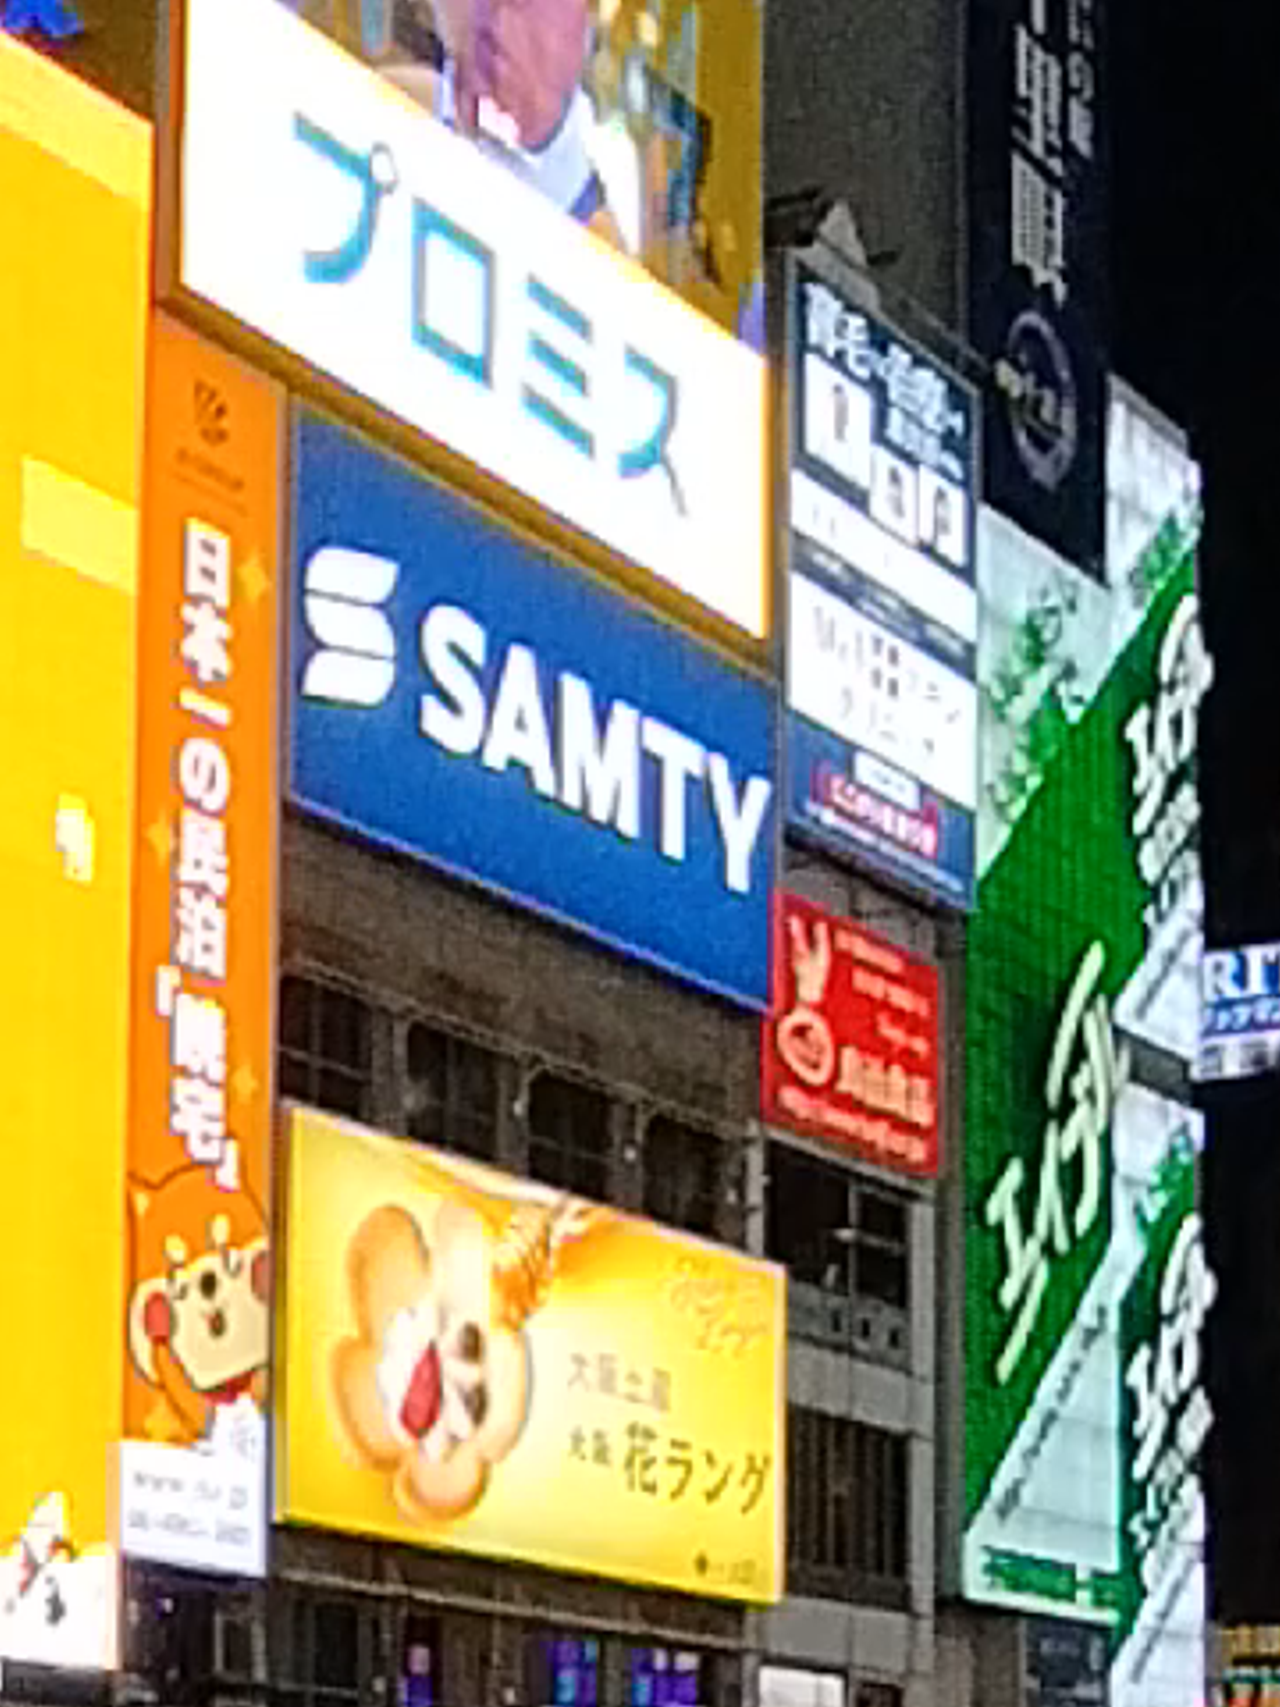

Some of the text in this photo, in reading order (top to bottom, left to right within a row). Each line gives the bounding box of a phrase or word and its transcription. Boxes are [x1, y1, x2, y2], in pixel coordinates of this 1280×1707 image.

[290, 110, 690, 517] プロミス
[416, 603, 774, 893] SAMTY
